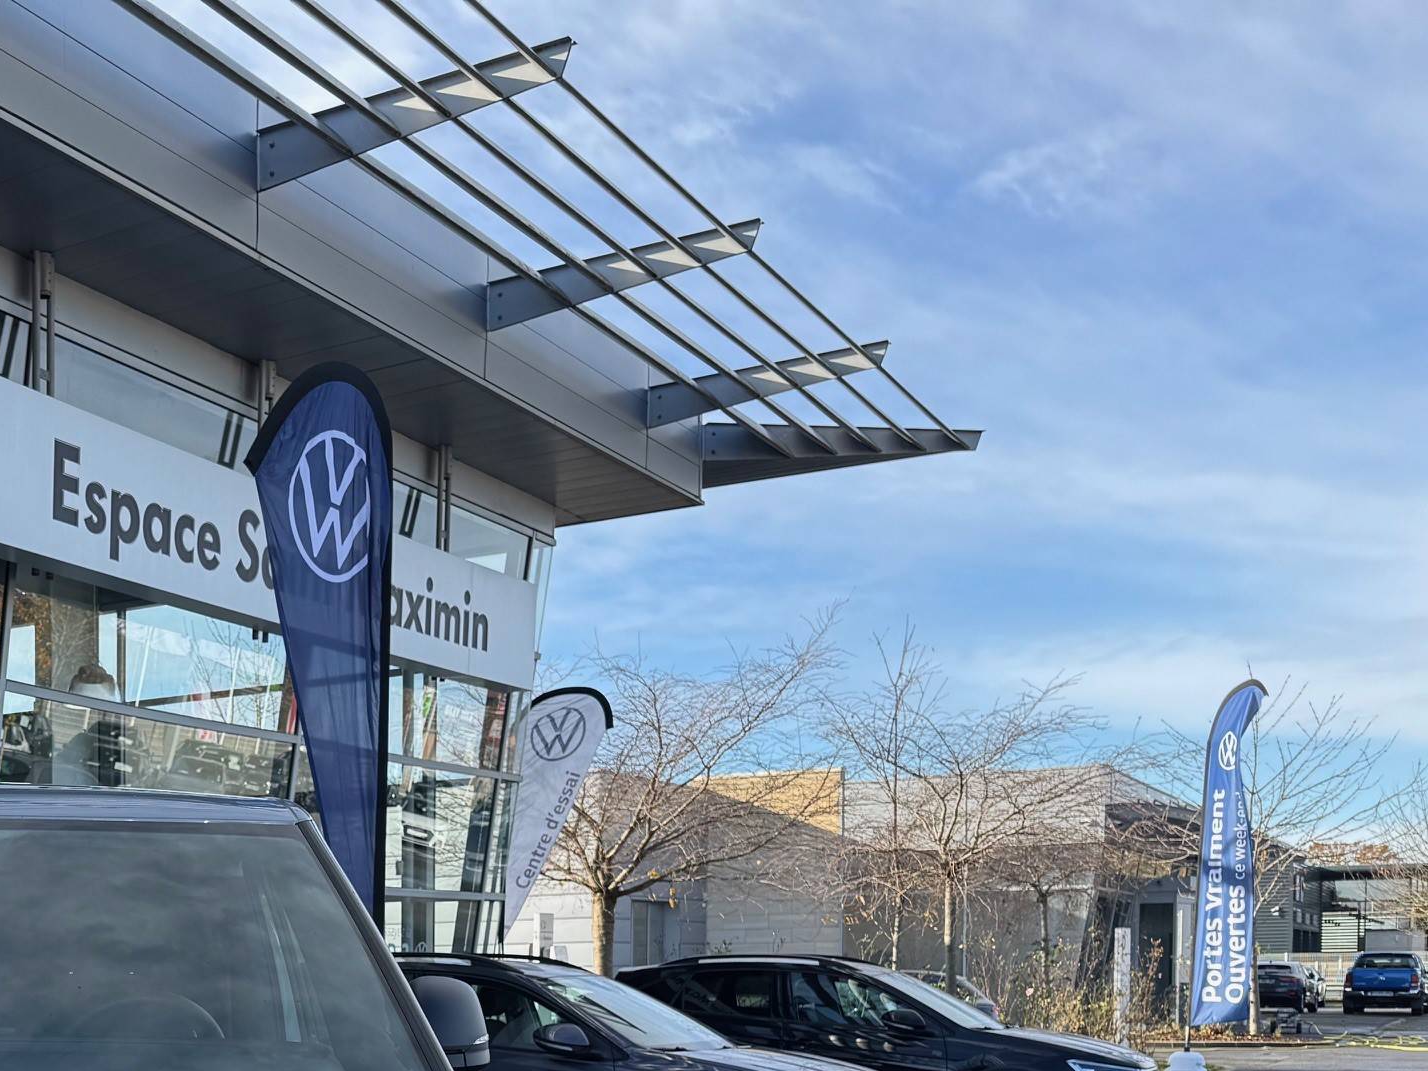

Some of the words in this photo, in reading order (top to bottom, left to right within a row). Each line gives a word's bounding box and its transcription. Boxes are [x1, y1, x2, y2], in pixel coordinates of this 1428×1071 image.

[53, 437, 221, 571] Espace
[390, 576, 489, 652] aximin
[515, 831, 552, 889] Centre
[545, 771, 581, 830] d'essai
[1205, 788, 1226, 911] Vraiment
[1235, 864, 1246, 880] ce
[1202, 918, 1223, 1003] Portes
[1225, 885, 1246, 1004] Ouvertes
